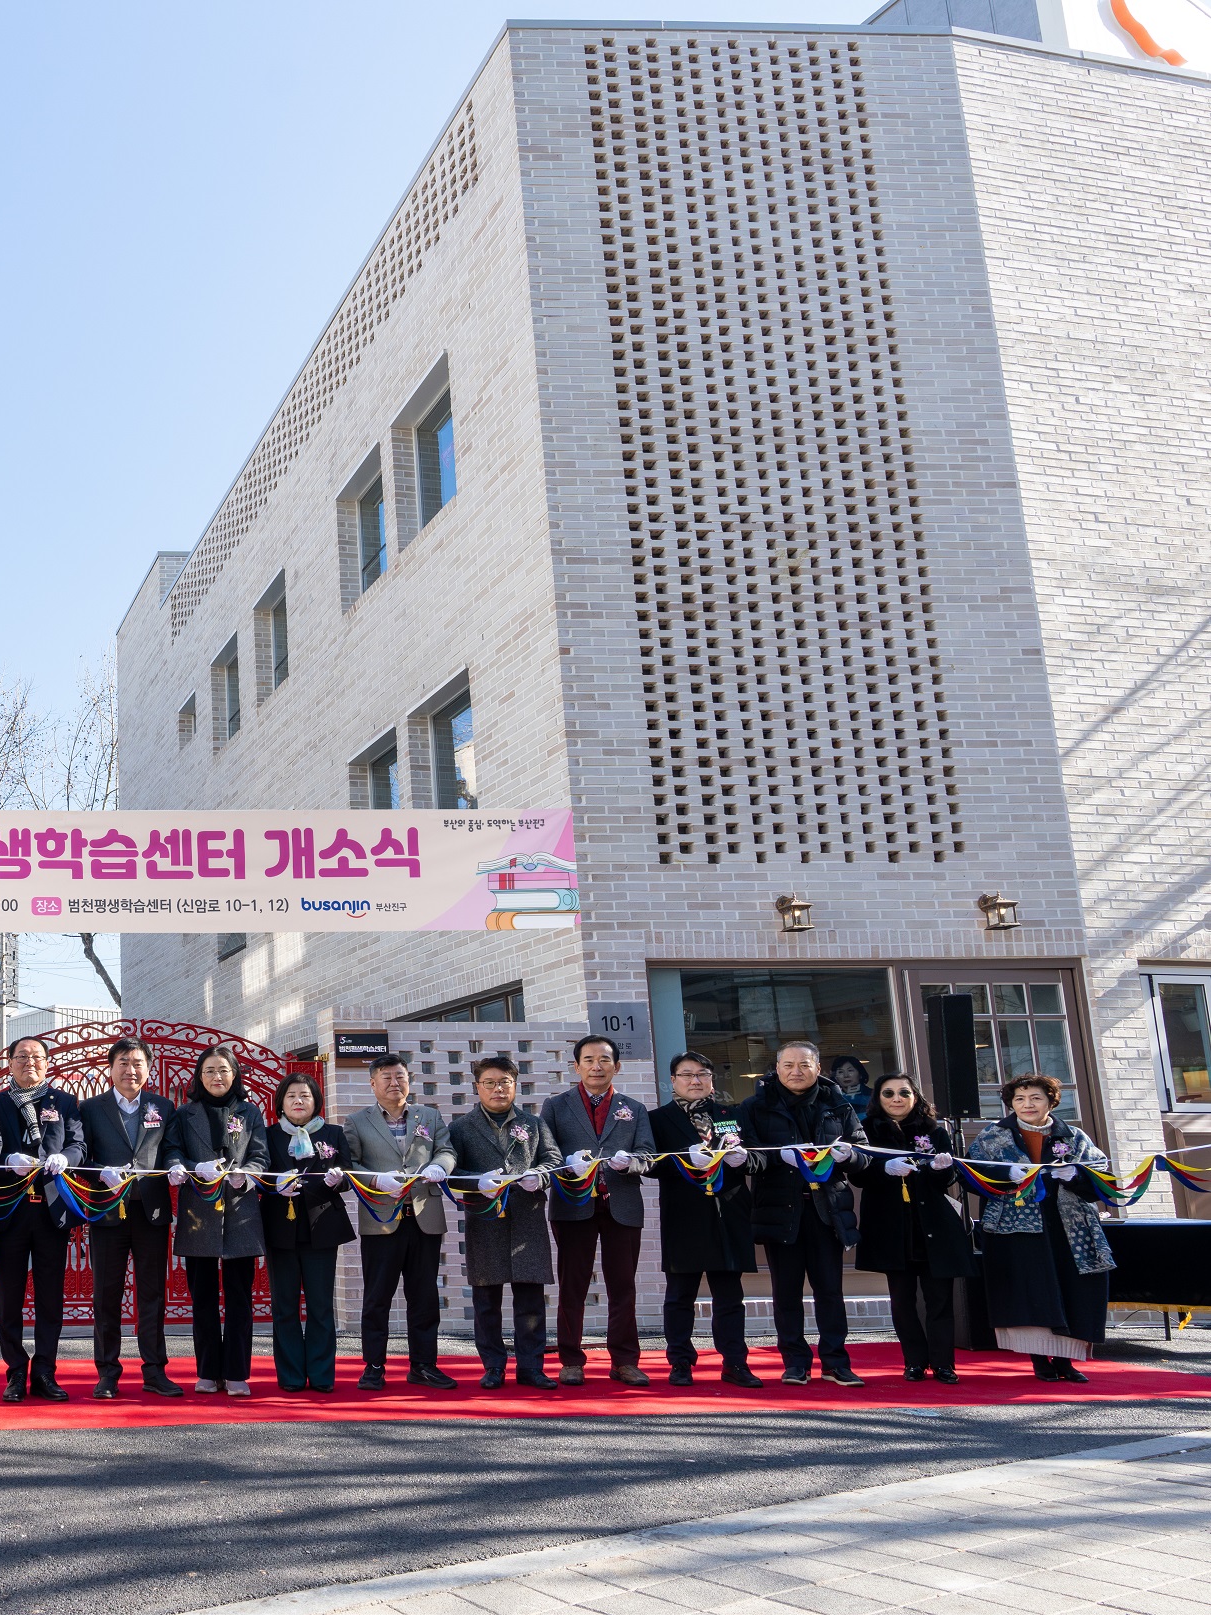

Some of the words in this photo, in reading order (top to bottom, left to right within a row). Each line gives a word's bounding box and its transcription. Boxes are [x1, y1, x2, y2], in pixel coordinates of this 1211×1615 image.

[443, 819, 466, 830] 부산의
[518, 818, 545, 830] 부산진구
[264, 827, 421, 879] 개소식
[35, 899, 59, 913] 장소
[68, 898, 172, 913] 범천평생학습센터
[176, 898, 221, 914] (신암로
[226, 898, 264, 914] 10-1,
[268, 898, 290, 914] 12)
[300, 897, 371, 915] busanjin
[375, 902, 408, 913] 부산진구
[601, 1015, 635, 1031] 10-1
[617, 1042, 632, 1050] 암로
